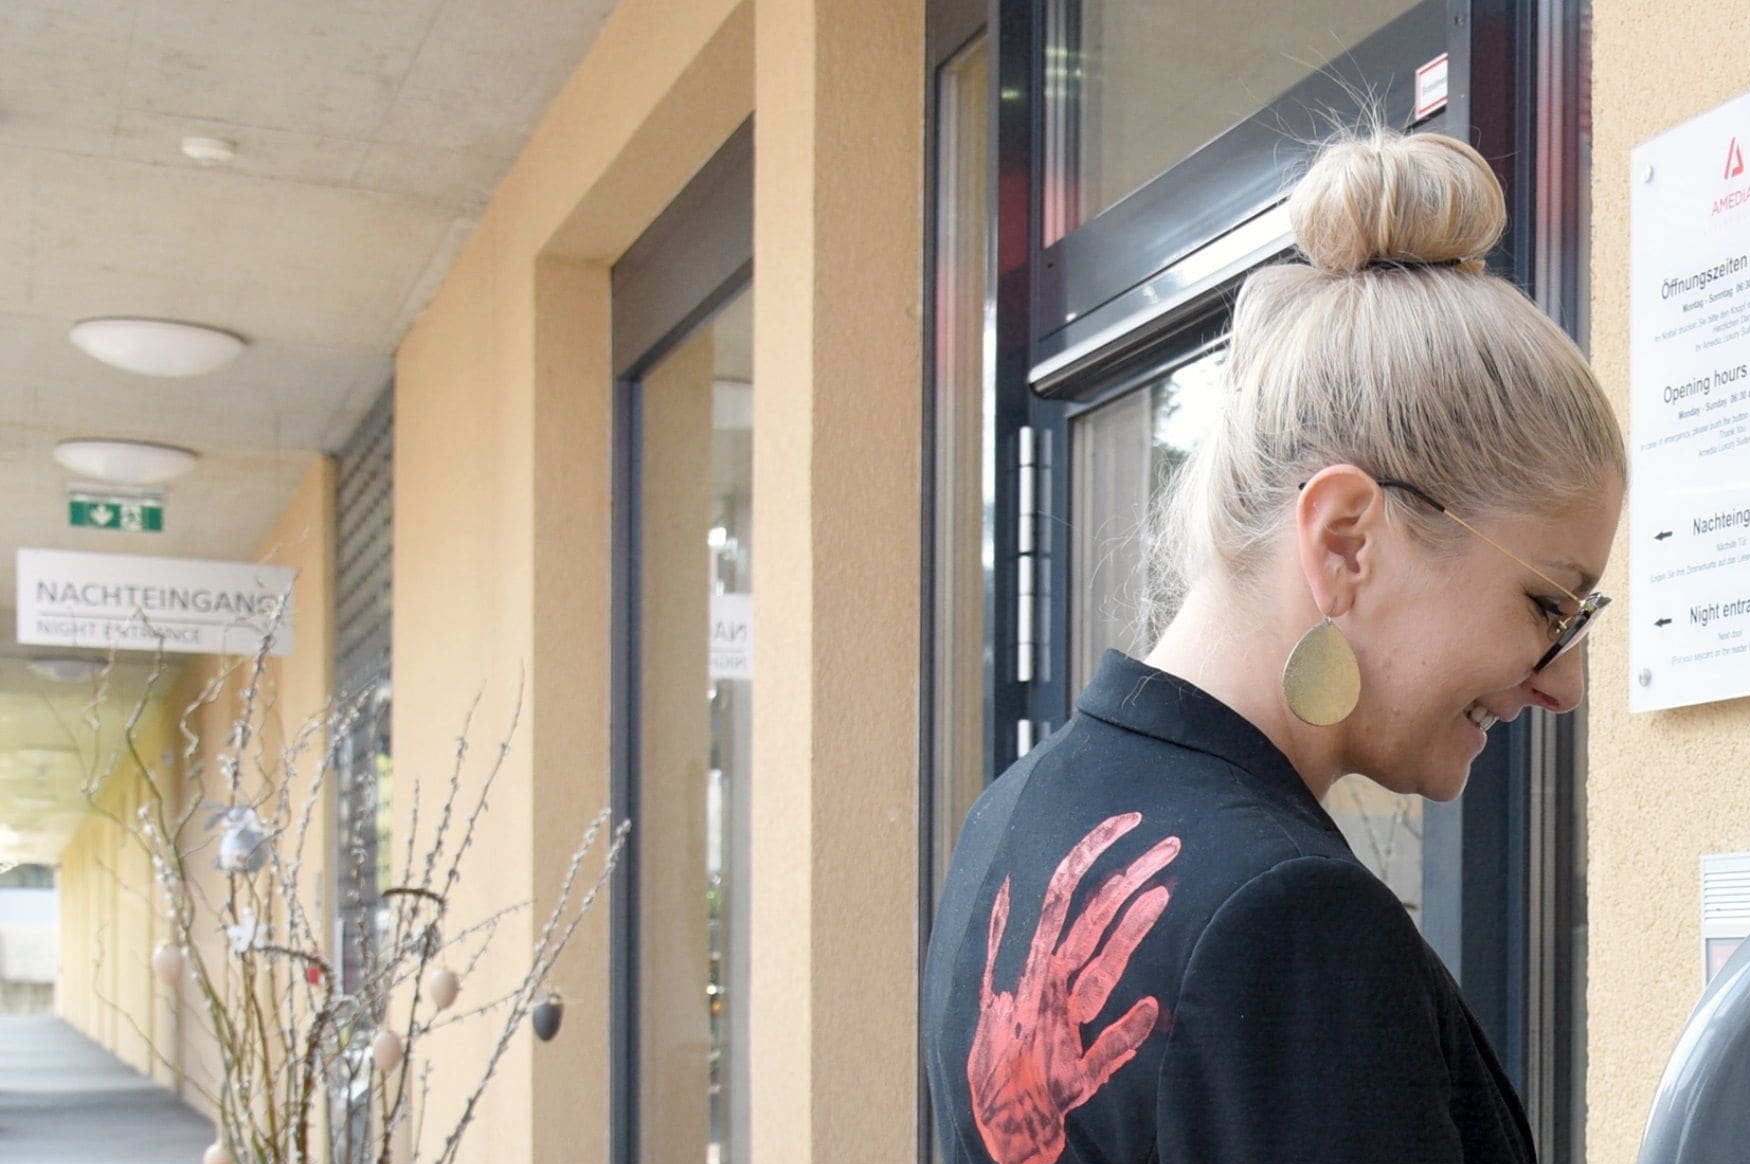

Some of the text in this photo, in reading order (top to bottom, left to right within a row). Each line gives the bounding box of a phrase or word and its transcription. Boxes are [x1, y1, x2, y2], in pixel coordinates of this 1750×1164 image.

[1660, 253, 1748, 301] Öffnungszeiten
[1663, 376, 1711, 406] Opening
[1714, 363, 1748, 388] hours
[1690, 602, 1720, 627] Night
